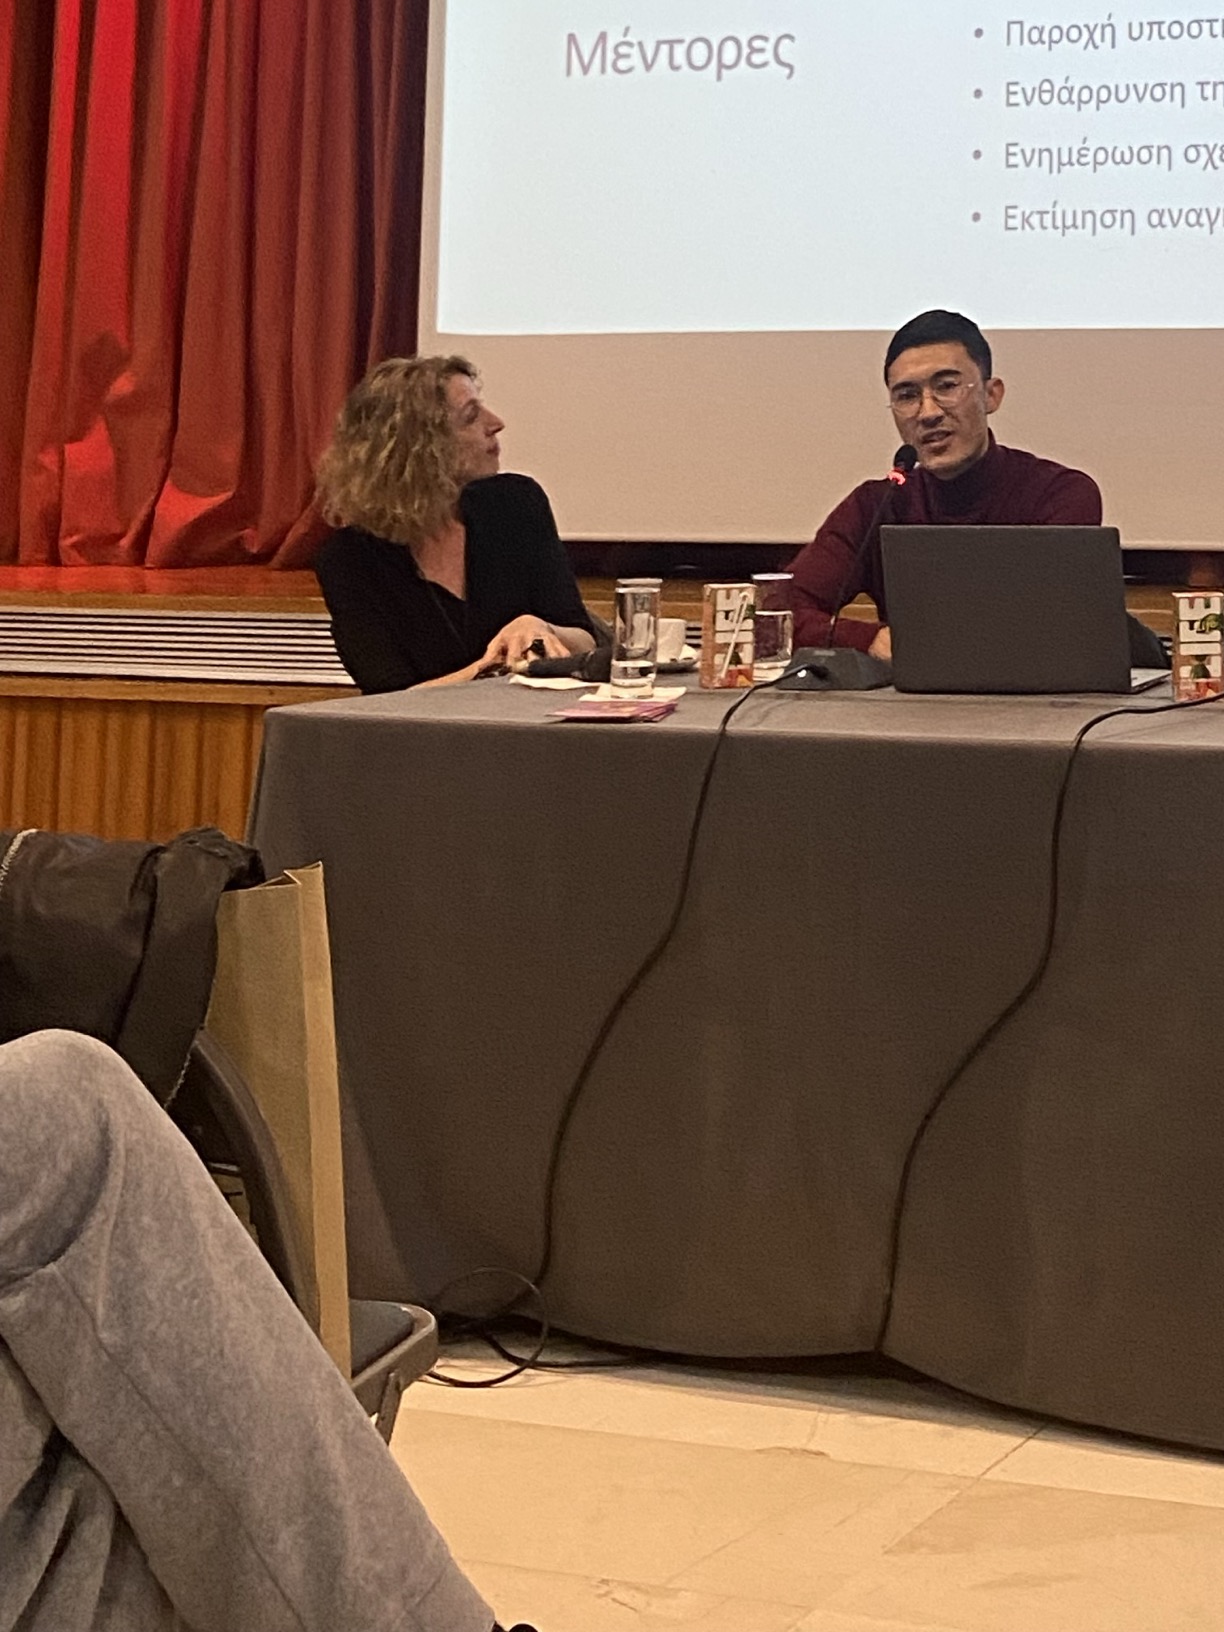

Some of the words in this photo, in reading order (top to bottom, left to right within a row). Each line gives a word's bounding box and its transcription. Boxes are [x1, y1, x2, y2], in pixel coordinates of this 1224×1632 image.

[1006, 12, 1117, 52] Παροχή
[565, 25, 796, 83] Μέντορες
[1005, 75, 1186, 113] Ενθάρρυνση
[1005, 136, 1173, 175] Ενημέρωση
[1004, 199, 1136, 238] Εκτίμηση
